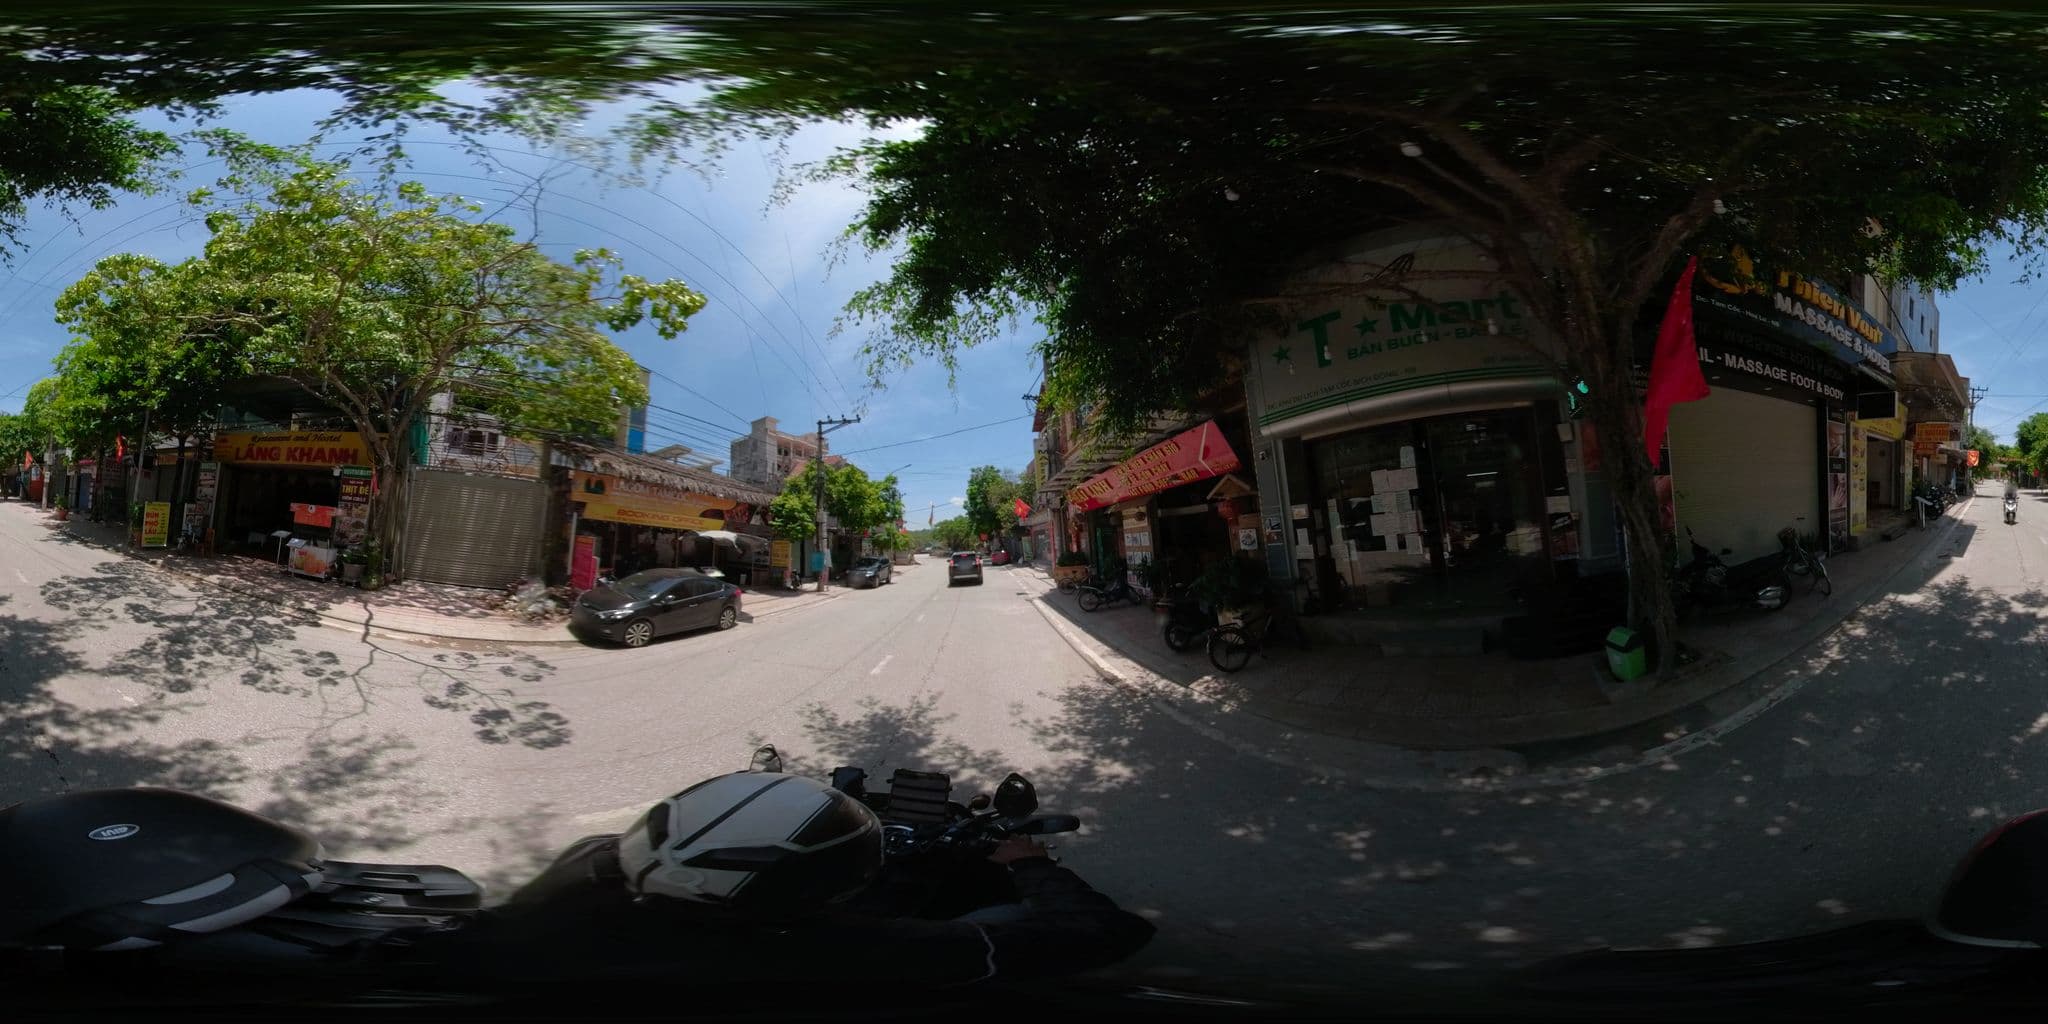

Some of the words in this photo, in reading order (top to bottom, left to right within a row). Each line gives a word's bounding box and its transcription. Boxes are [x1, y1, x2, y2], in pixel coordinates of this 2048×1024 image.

[1297, 310, 1342, 368] T
[1389, 290, 1522, 332] Mart
[1774, 292, 1853, 348] MASSAGE
[1853, 336, 1863, 354] &
[1863, 340, 1891, 374] HOTEL
[1724, 352, 1789, 382] MASSAGE
[1790, 371, 1816, 390] FOOT
[1816, 381, 1823, 393] &
[1823, 384, 1845, 401] BODY
[285, 447, 359, 465] KHANH
